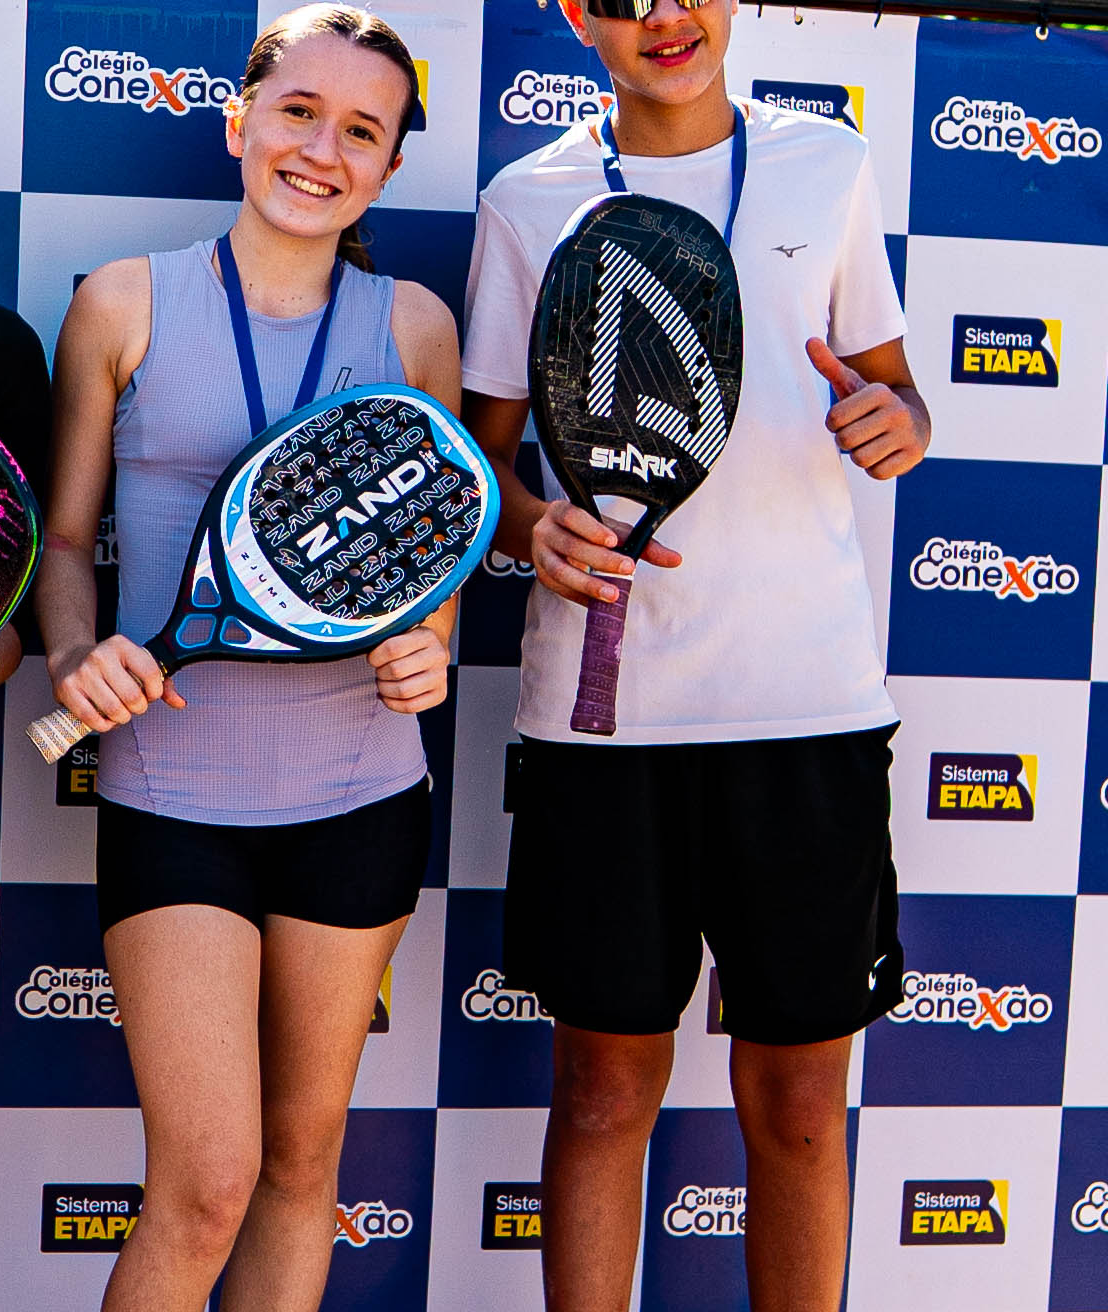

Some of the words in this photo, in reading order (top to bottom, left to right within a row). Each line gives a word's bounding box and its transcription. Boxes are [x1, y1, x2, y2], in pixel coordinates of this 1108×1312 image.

[65, 49, 145, 74] Colégio
[518, 74, 595, 98] Colégio
[949, 100, 1022, 125] Colégio
[638, 209, 714, 258] BLACK
[676, 246, 718, 280] PRO
[965, 327, 1032, 348] Sistema
[963, 347, 1048, 376] ETAPA
[270, 405, 343, 465] ZAND
[347, 426, 425, 487] ZAND
[589, 442, 678, 483] SHARK
[297, 459, 426, 562] ZAND
[384, 473, 460, 533] ZAND
[266, 487, 342, 547] ZAND
[301, 532, 378, 593] ZAND
[929, 540, 999, 564] Colégio
[941, 765, 1009, 783] Sistema
[939, 784, 1023, 809] ETAPA
[34, 969, 113, 991] Colégio
[903, 974, 973, 996] Colégio
[55, 1196, 129, 1214] Sistema
[496, 1195, 542, 1211] Siste
[681, 1189, 746, 1209] Colégi
[913, 1192, 980, 1208] Sistema
[494, 1214, 541, 1237] ETA
[912, 1210, 994, 1234] ETAPA
